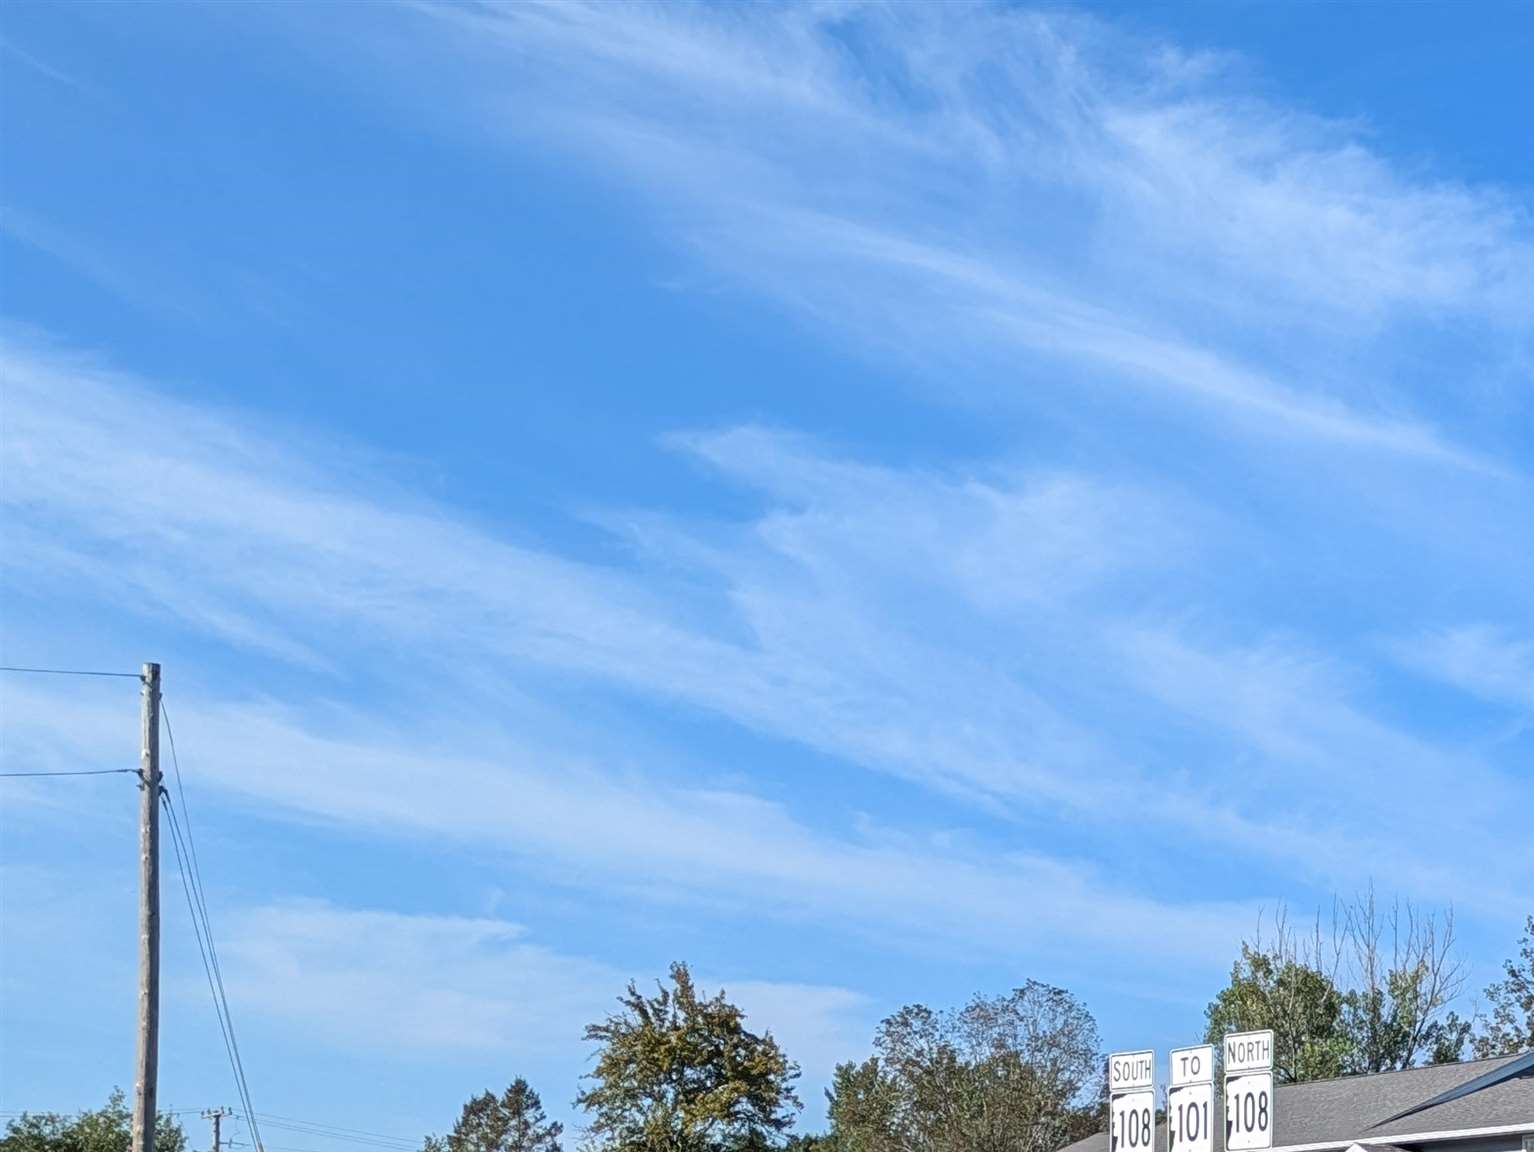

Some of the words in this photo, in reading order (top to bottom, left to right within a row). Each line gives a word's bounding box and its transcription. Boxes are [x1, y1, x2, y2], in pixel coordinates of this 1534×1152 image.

[1180, 1056, 1201, 1077] TO
[1227, 1039, 1270, 1064] NORTH
[1113, 1059, 1151, 1082] SOUTH
[1119, 1107, 1151, 1148] 108
[1178, 1101, 1208, 1143] 101
[1234, 1090, 1269, 1133] 108
